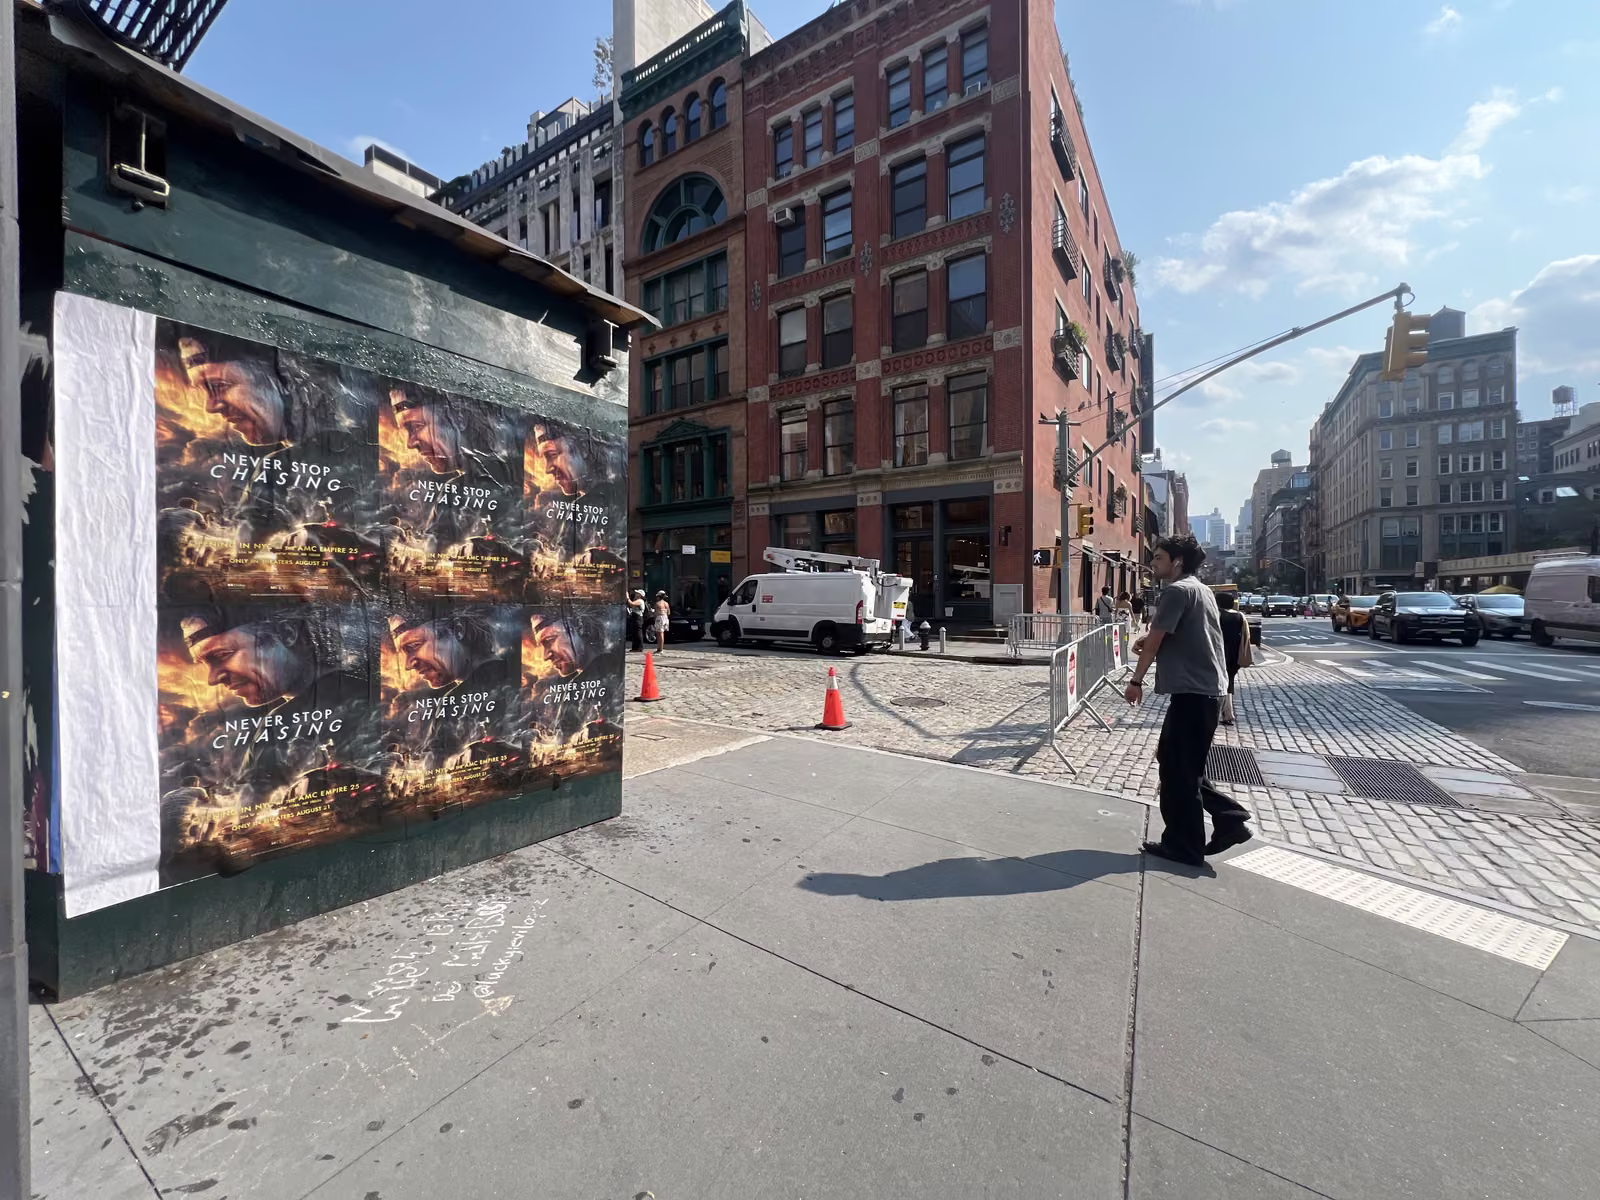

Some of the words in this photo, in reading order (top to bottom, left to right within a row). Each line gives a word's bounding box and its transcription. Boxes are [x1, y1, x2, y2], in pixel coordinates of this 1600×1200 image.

[224, 452, 282, 471] NEVER
[291, 461, 331, 477] STOP
[210, 464, 341, 491] CHASING
[418, 480, 457, 494] NEVER
[463, 486, 491, 498] STOP
[409, 490, 498, 511] CHASING
[552, 500, 582, 512] NEVER
[583, 504, 604, 515] STOP
[546, 508, 609, 526] CHASING
[320, 546, 347, 554] EMPIRE
[549, 682, 579, 693] NEVER
[581, 679, 601, 689] STOP
[416, 695, 456, 709] NEVER
[461, 692, 489, 703] STOP
[543, 687, 606, 705] CHASING
[225, 714, 283, 732] NEVER
[292, 709, 332, 724] STOP
[407, 700, 496, 723] CHASING
[212, 719, 343, 749] CHASING
[480, 756, 499, 765] EMPIRE
[241, 805, 252, 813] IN
[298, 791, 318, 801] AMC
[320, 785, 348, 797] EMPIRE
[349, 783, 360, 791] 25
[231, 822, 251, 831] ONLY
[296, 806, 322, 817] AUGUST
